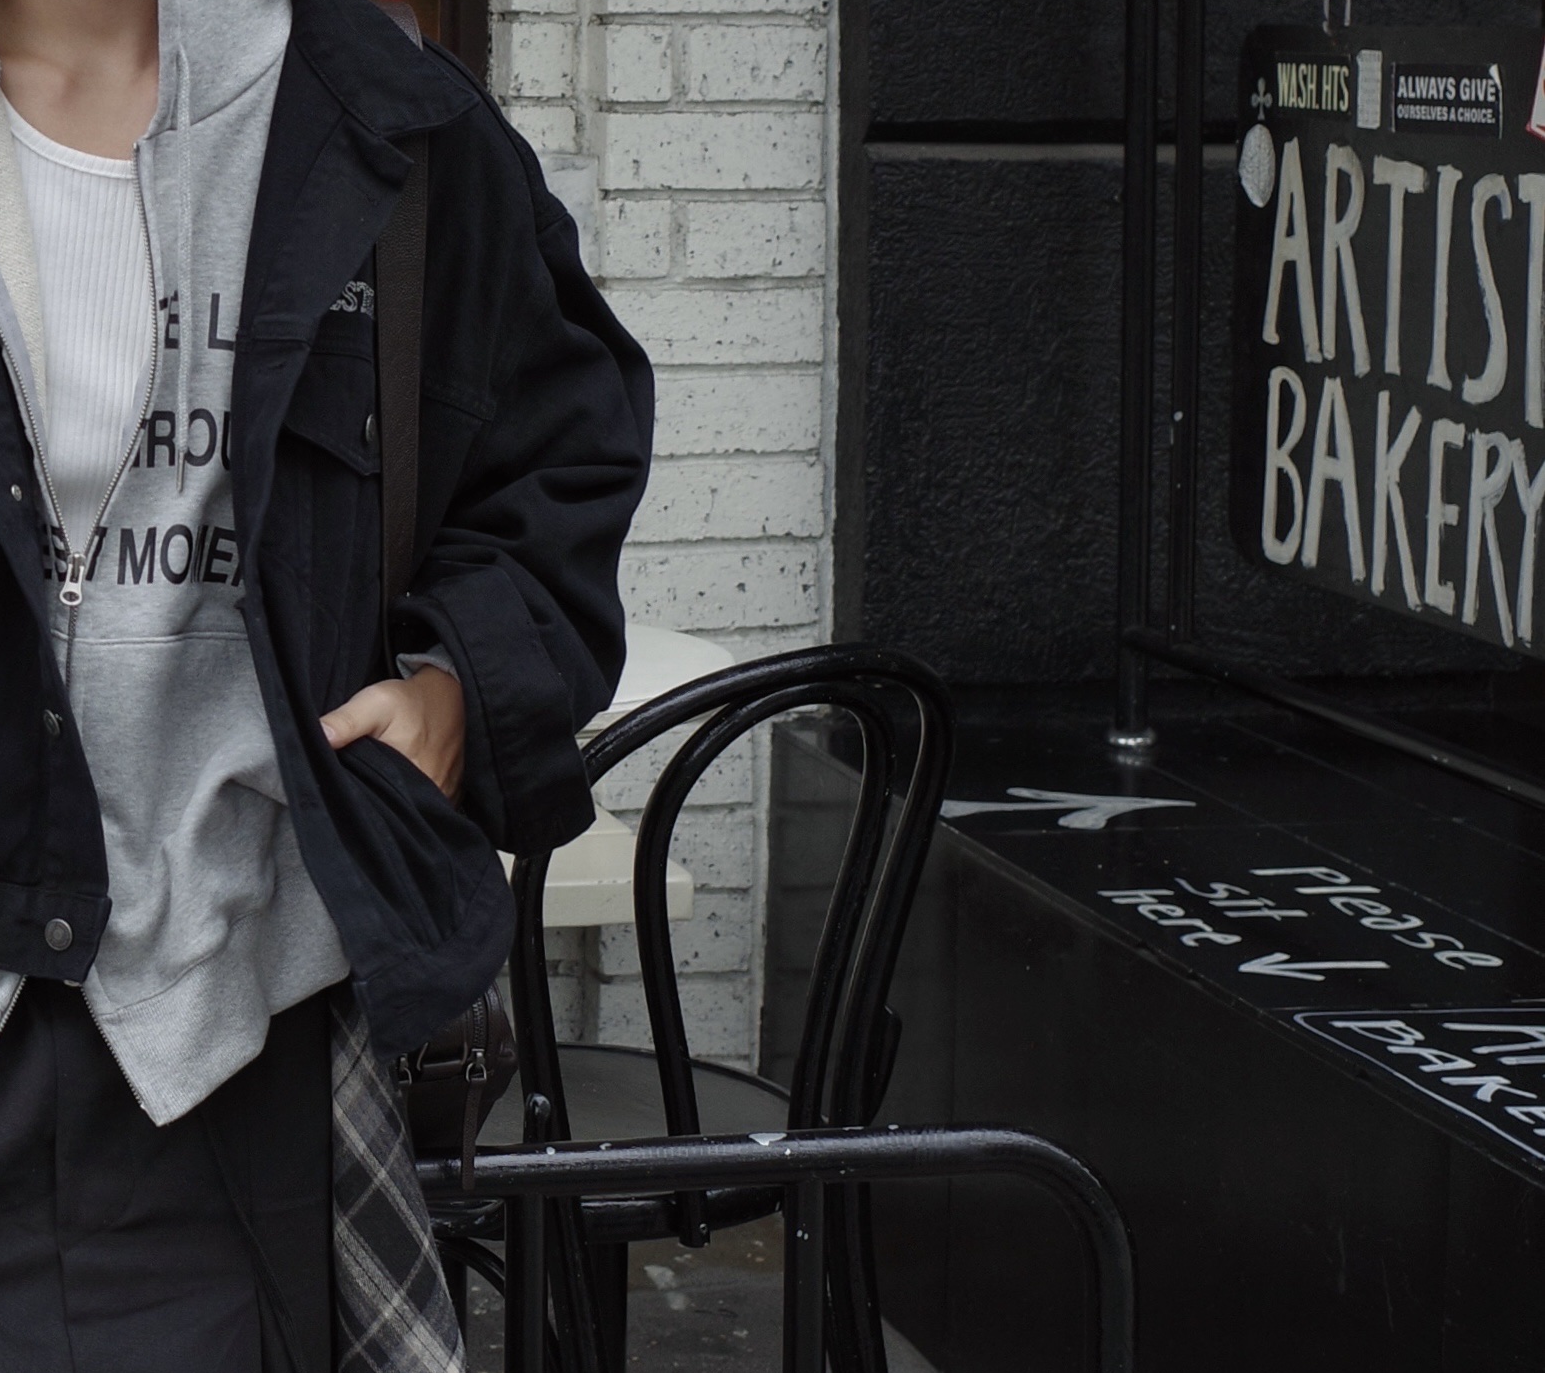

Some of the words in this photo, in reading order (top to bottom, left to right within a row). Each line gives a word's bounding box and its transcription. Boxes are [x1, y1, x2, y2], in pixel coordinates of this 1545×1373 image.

[1321, 65, 1350, 112] HTS
[1396, 75, 1456, 101] ALWAYS
[1459, 77, 1497, 103] GIVE
[1396, 103, 1449, 121] OURSELVES
[1449, 105, 1458, 122] A
[1097, 888, 1243, 948] here
[1174, 877, 1309, 922] sit
[1250, 865, 1504, 970] Please
